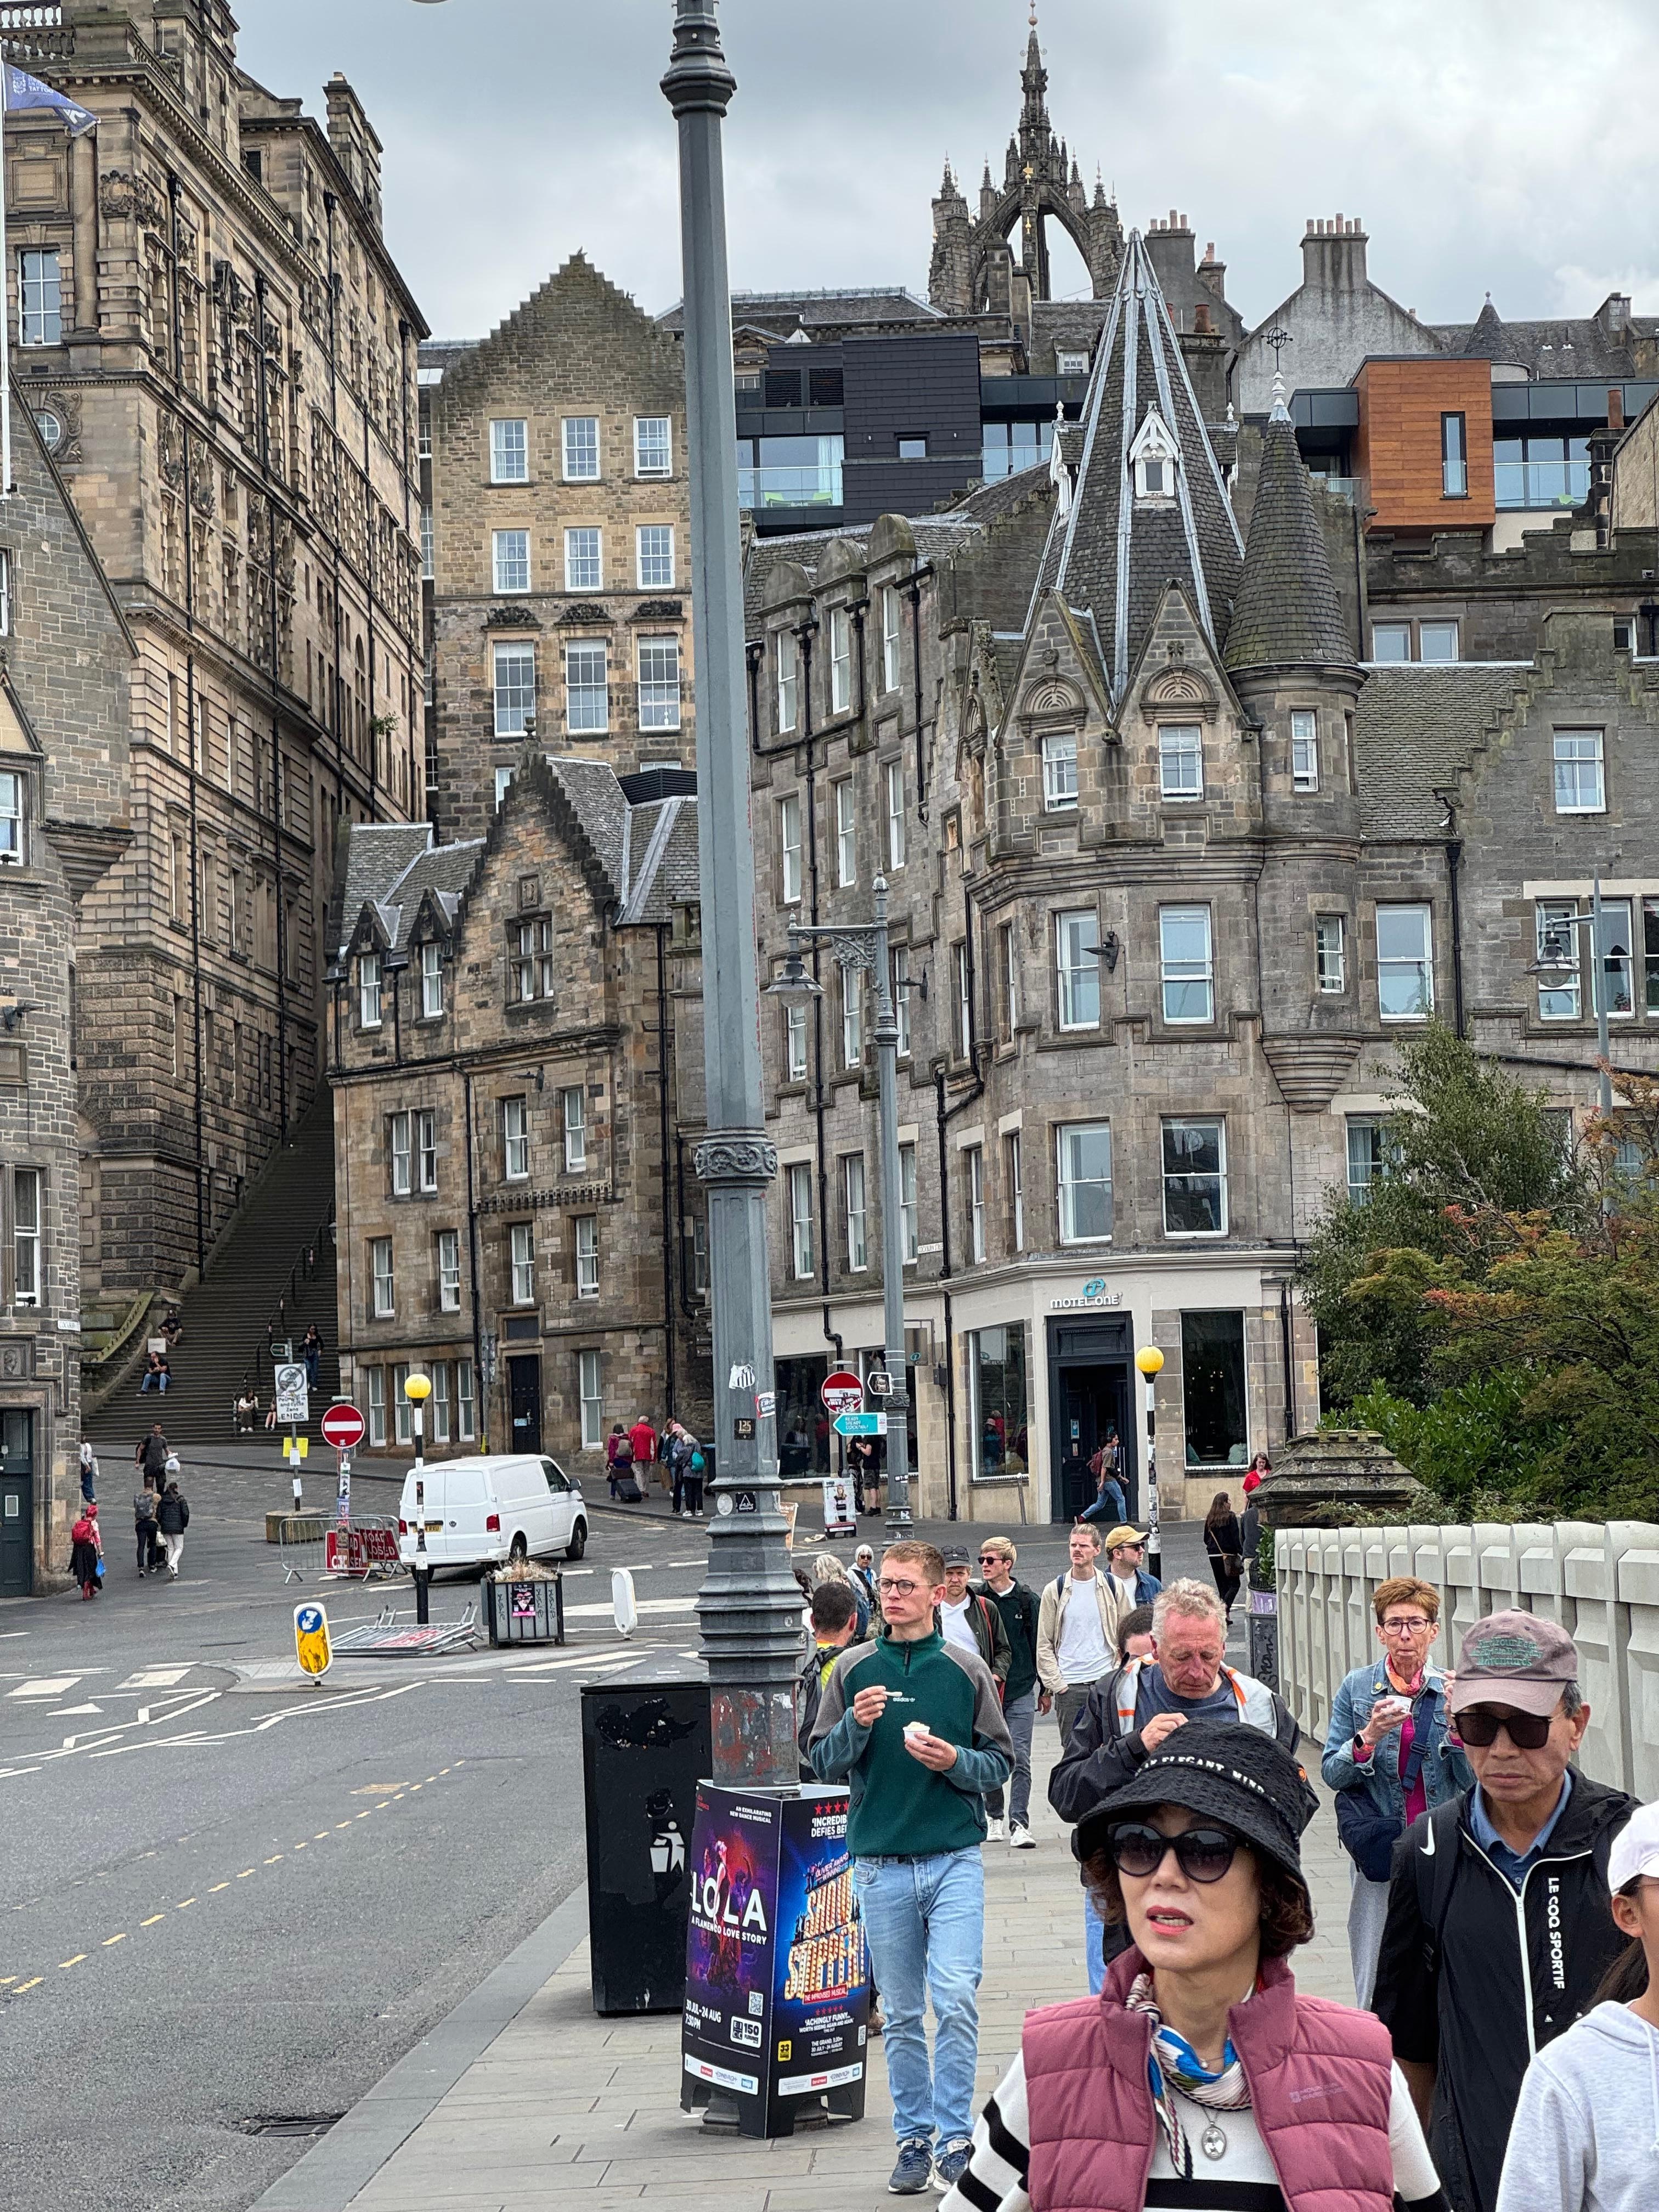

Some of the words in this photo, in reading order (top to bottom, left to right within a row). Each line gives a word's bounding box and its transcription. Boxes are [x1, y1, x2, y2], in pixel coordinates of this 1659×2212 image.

[1050, 1296, 1091, 1308] MOTEL
[1094, 1295, 1119, 1306] ONE
[281, 1412, 304, 1420] ENDS
[752, 1815, 772, 1824] MUSICAL
[812, 1814, 847, 1827] 'INCREDIB
[811, 1826, 836, 1838] DEFIES
[1548, 1877, 1560, 1894] LE
[692, 1871, 768, 1932] LOLA
[1548, 1896, 1561, 1929] COQ
[695, 1917, 721, 1934] FLAMENCO
[723, 1926, 740, 1940] LOVE
[741, 1932, 767, 1945] STORY
[1549, 1931, 1565, 1989] SPORTIF
[708, 2008, 721, 2023] AUG
[744, 2023, 759, 2036] 150
[780, 2044, 789, 2052] 33
